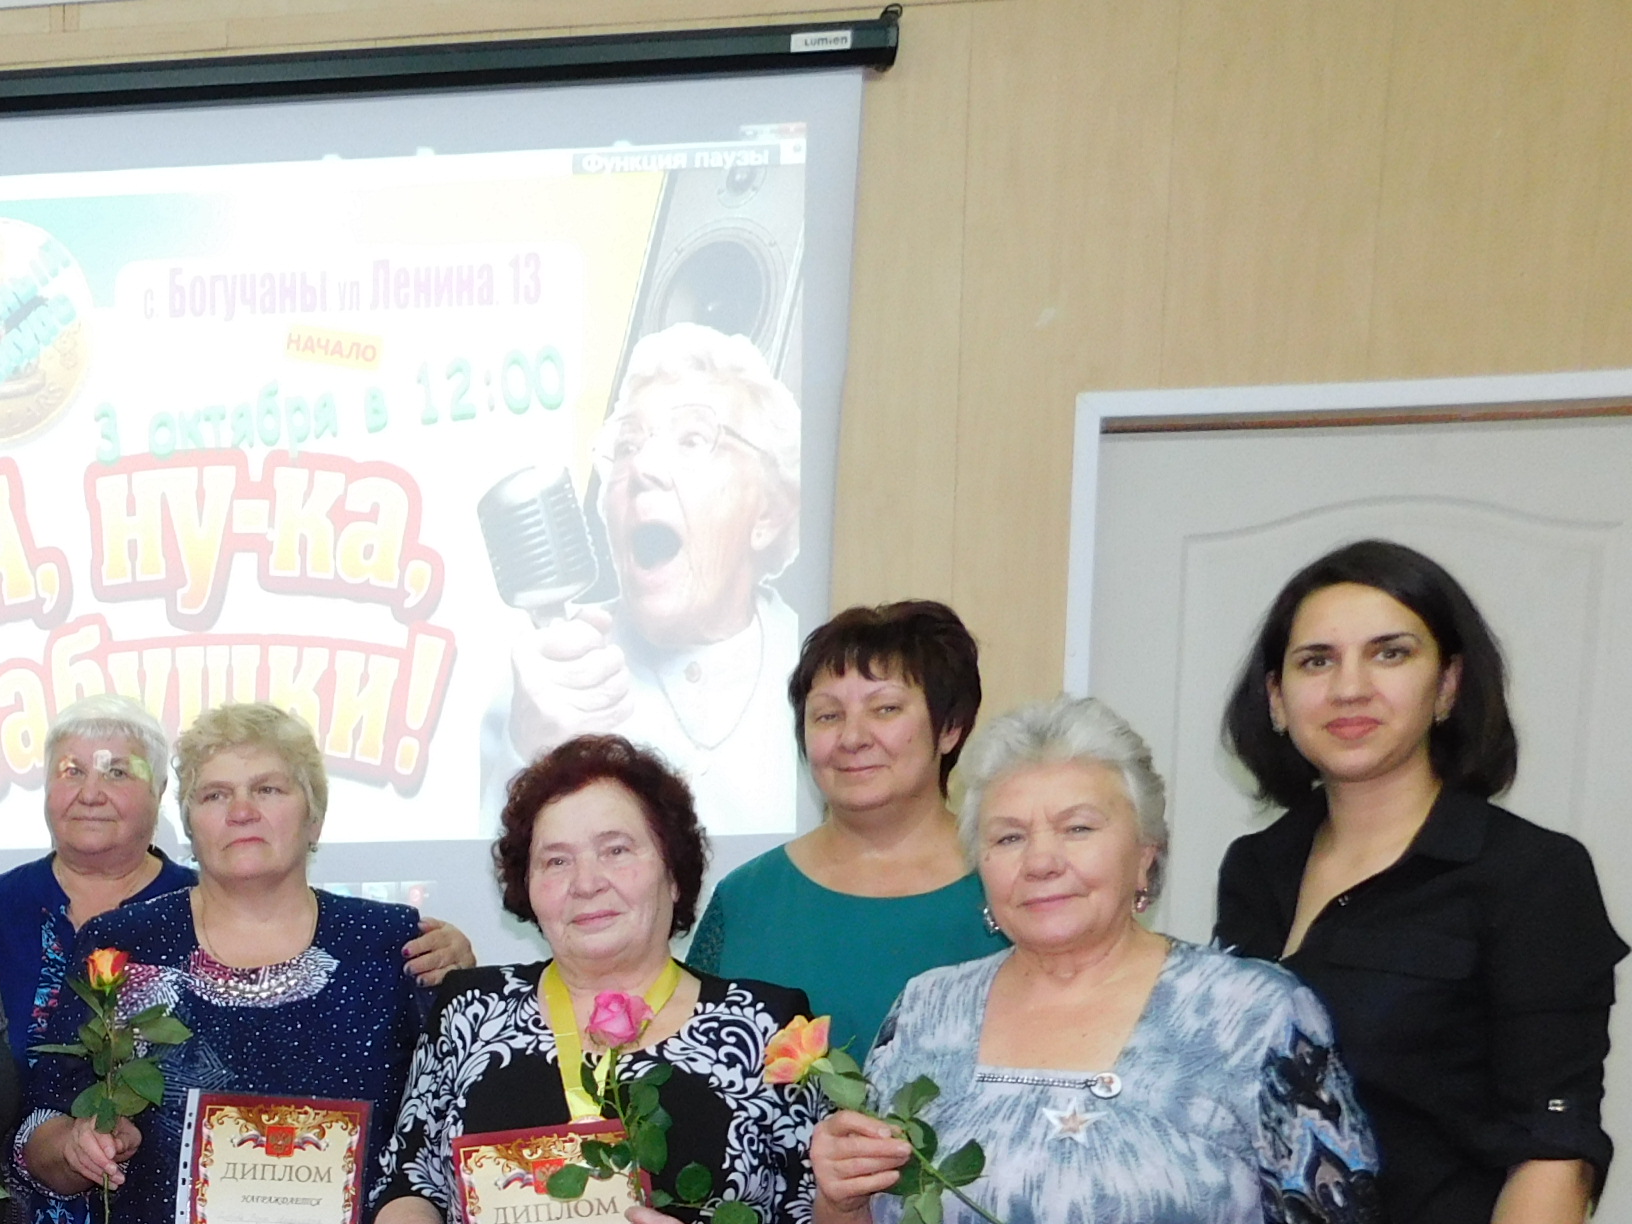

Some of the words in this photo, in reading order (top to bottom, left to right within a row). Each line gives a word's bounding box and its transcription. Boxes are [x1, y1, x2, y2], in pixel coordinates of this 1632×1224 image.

[582, 150, 688, 174] Функция
[694, 147, 769, 170] паузы
[508, 252, 543, 306] 13
[286, 332, 378, 363] НАЧАЛО
[94, 402, 123, 466] 3
[148, 379, 338, 462] октября
[363, 385, 389, 435] в
[415, 344, 567, 427] 12:00
[88, 452, 442, 624] ну-ка,
[220, 1161, 334, 1184] ДИПЛОМ
[241, 1194, 323, 1207] НАГРАЖДАЕТСЯ
